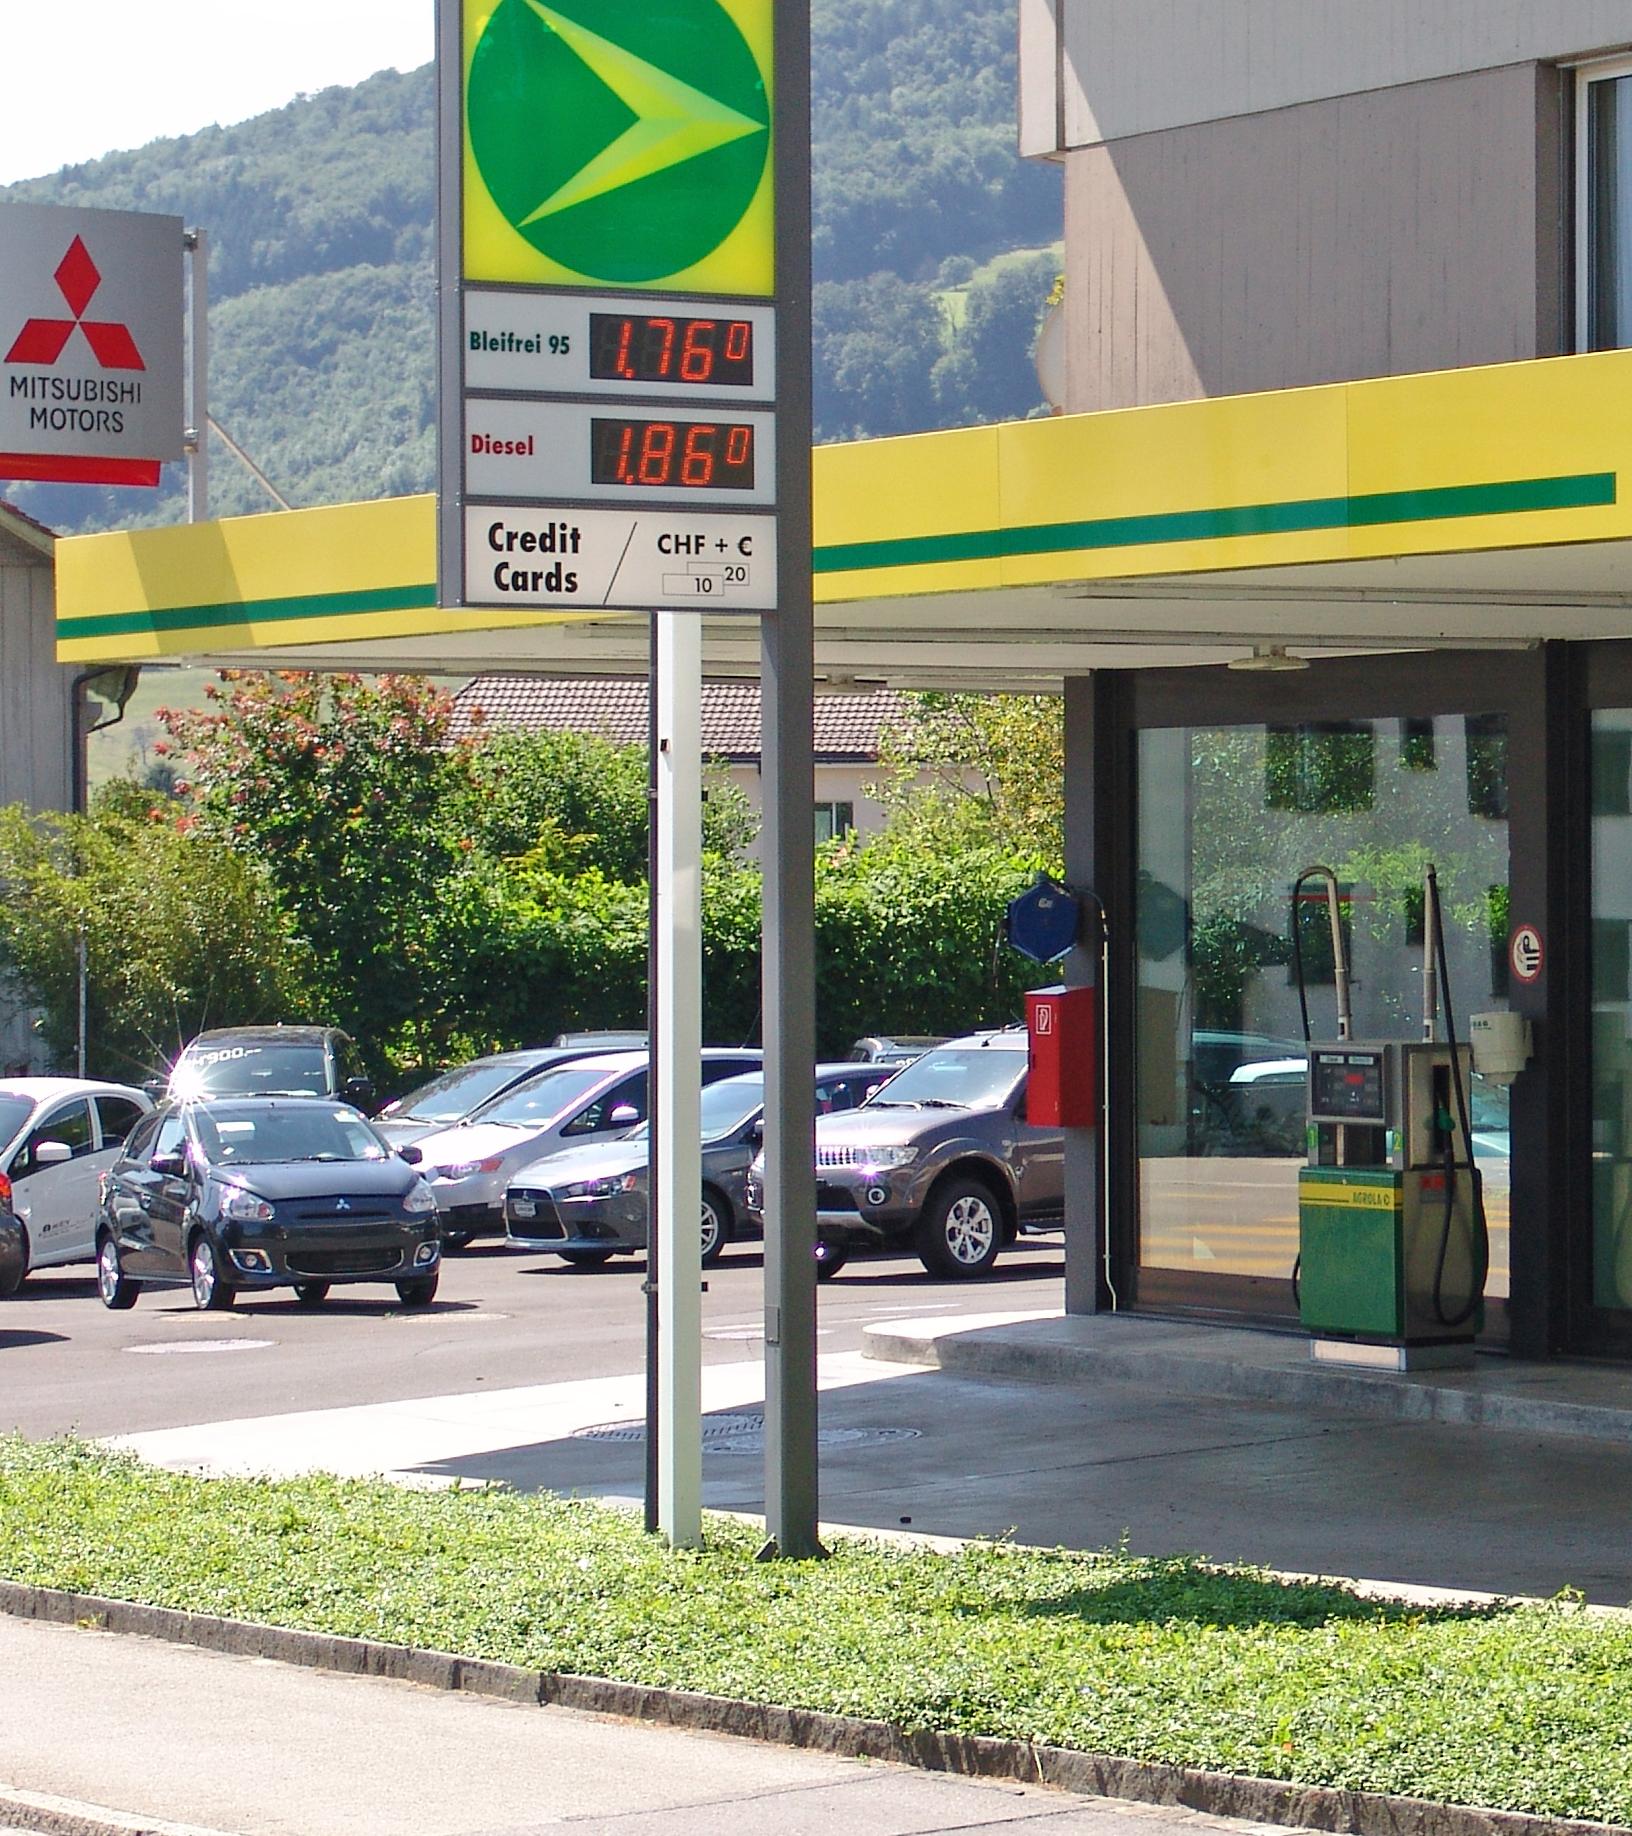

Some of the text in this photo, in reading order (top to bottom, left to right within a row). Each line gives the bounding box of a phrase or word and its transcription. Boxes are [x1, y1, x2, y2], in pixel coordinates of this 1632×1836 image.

[469, 331, 570, 355] Bleifrei 95
[10, 375, 142, 404] MITSUBISHI
[30, 407, 124, 433] MOTORS
[470, 434, 534, 456] Diesel
[488, 522, 582, 554] Credit
[657, 533, 706, 555] CHF
[714, 537, 728, 553] +
[493, 562, 579, 593] Cards
[694, 577, 712, 593] 10
[724, 566, 746, 582] 20
